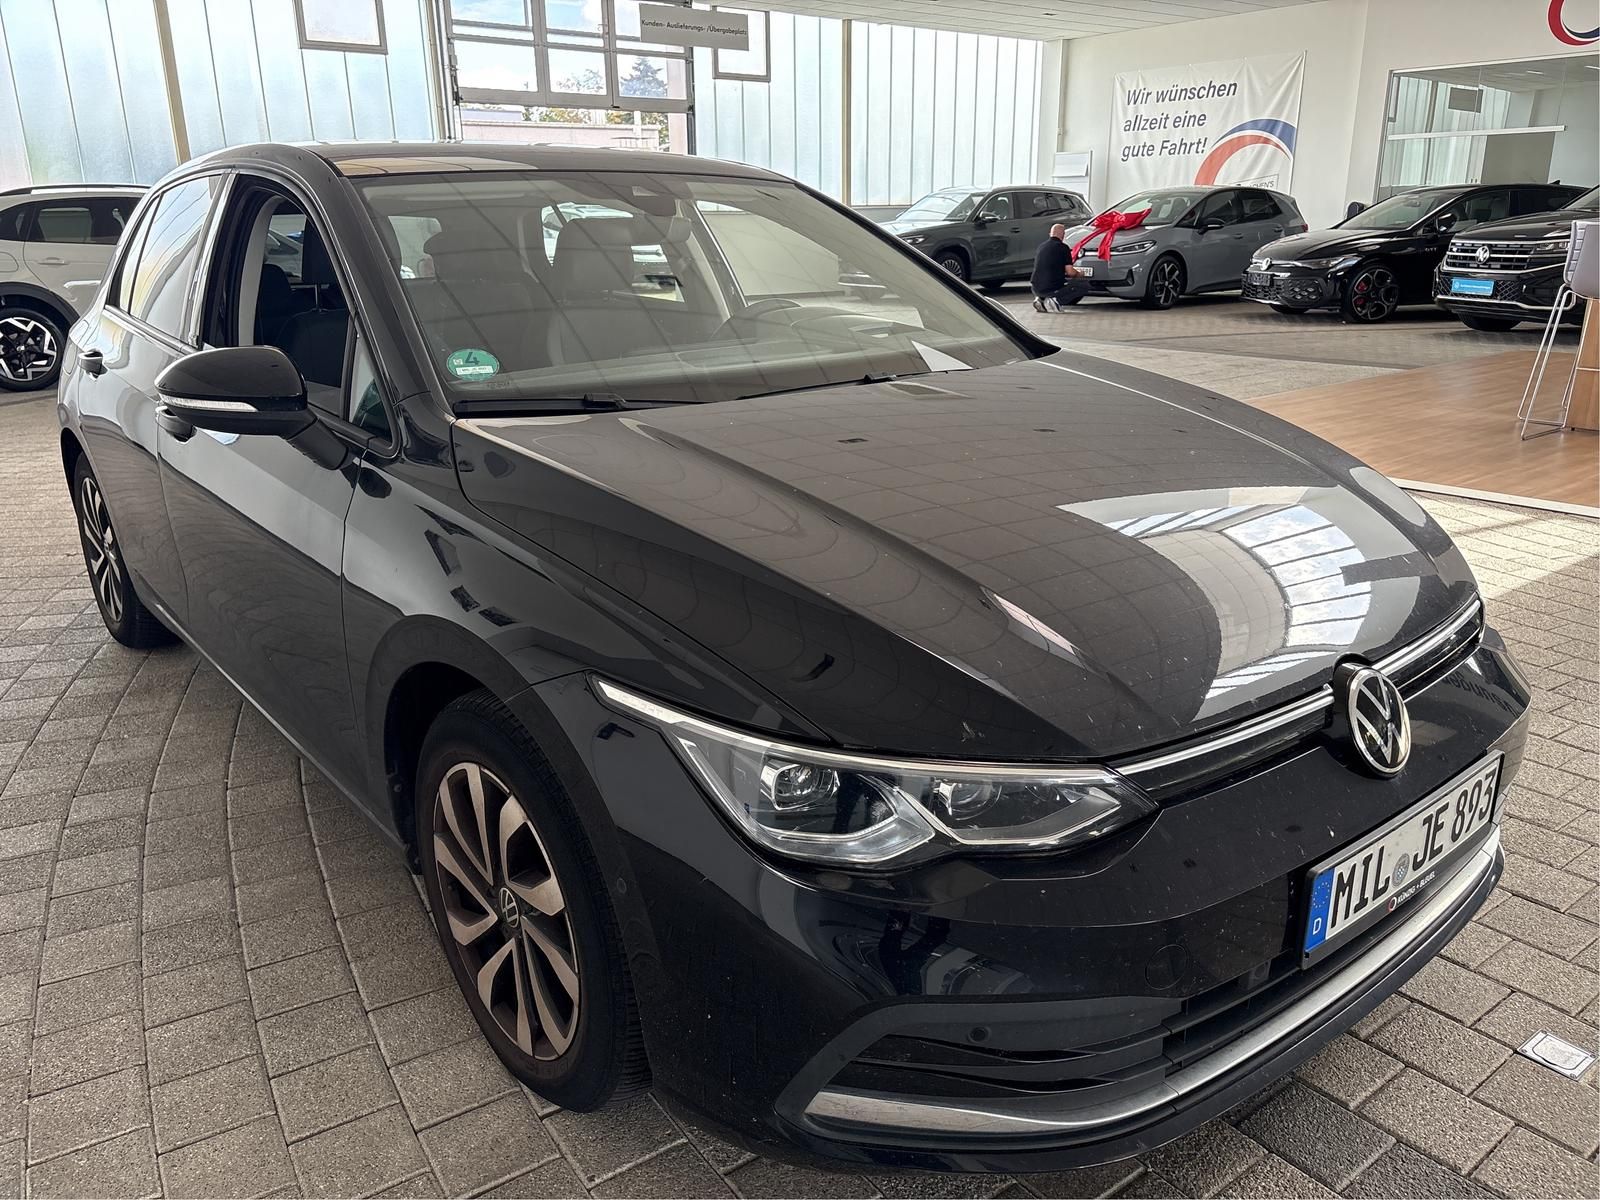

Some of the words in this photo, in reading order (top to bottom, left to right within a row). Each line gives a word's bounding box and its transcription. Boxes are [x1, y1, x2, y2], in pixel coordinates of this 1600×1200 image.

[641, 19, 665, 27] Kunden-
[666, 21, 705, 32] Auslieferungs-
[1127, 87, 1152, 106] Wir
[1156, 80, 1238, 104] wünschen
[1123, 114, 1169, 132] allzeit
[1172, 111, 1207, 128] eine
[1121, 143, 1155, 162] gute
[1158, 137, 1208, 157] Fahrt!
[464, 351, 480, 366] 4
[1330, 846, 1390, 928] MIL
[1412, 801, 1449, 871] JE
[1451, 766, 1496, 843] 893
[1312, 917, 1322, 935] D
